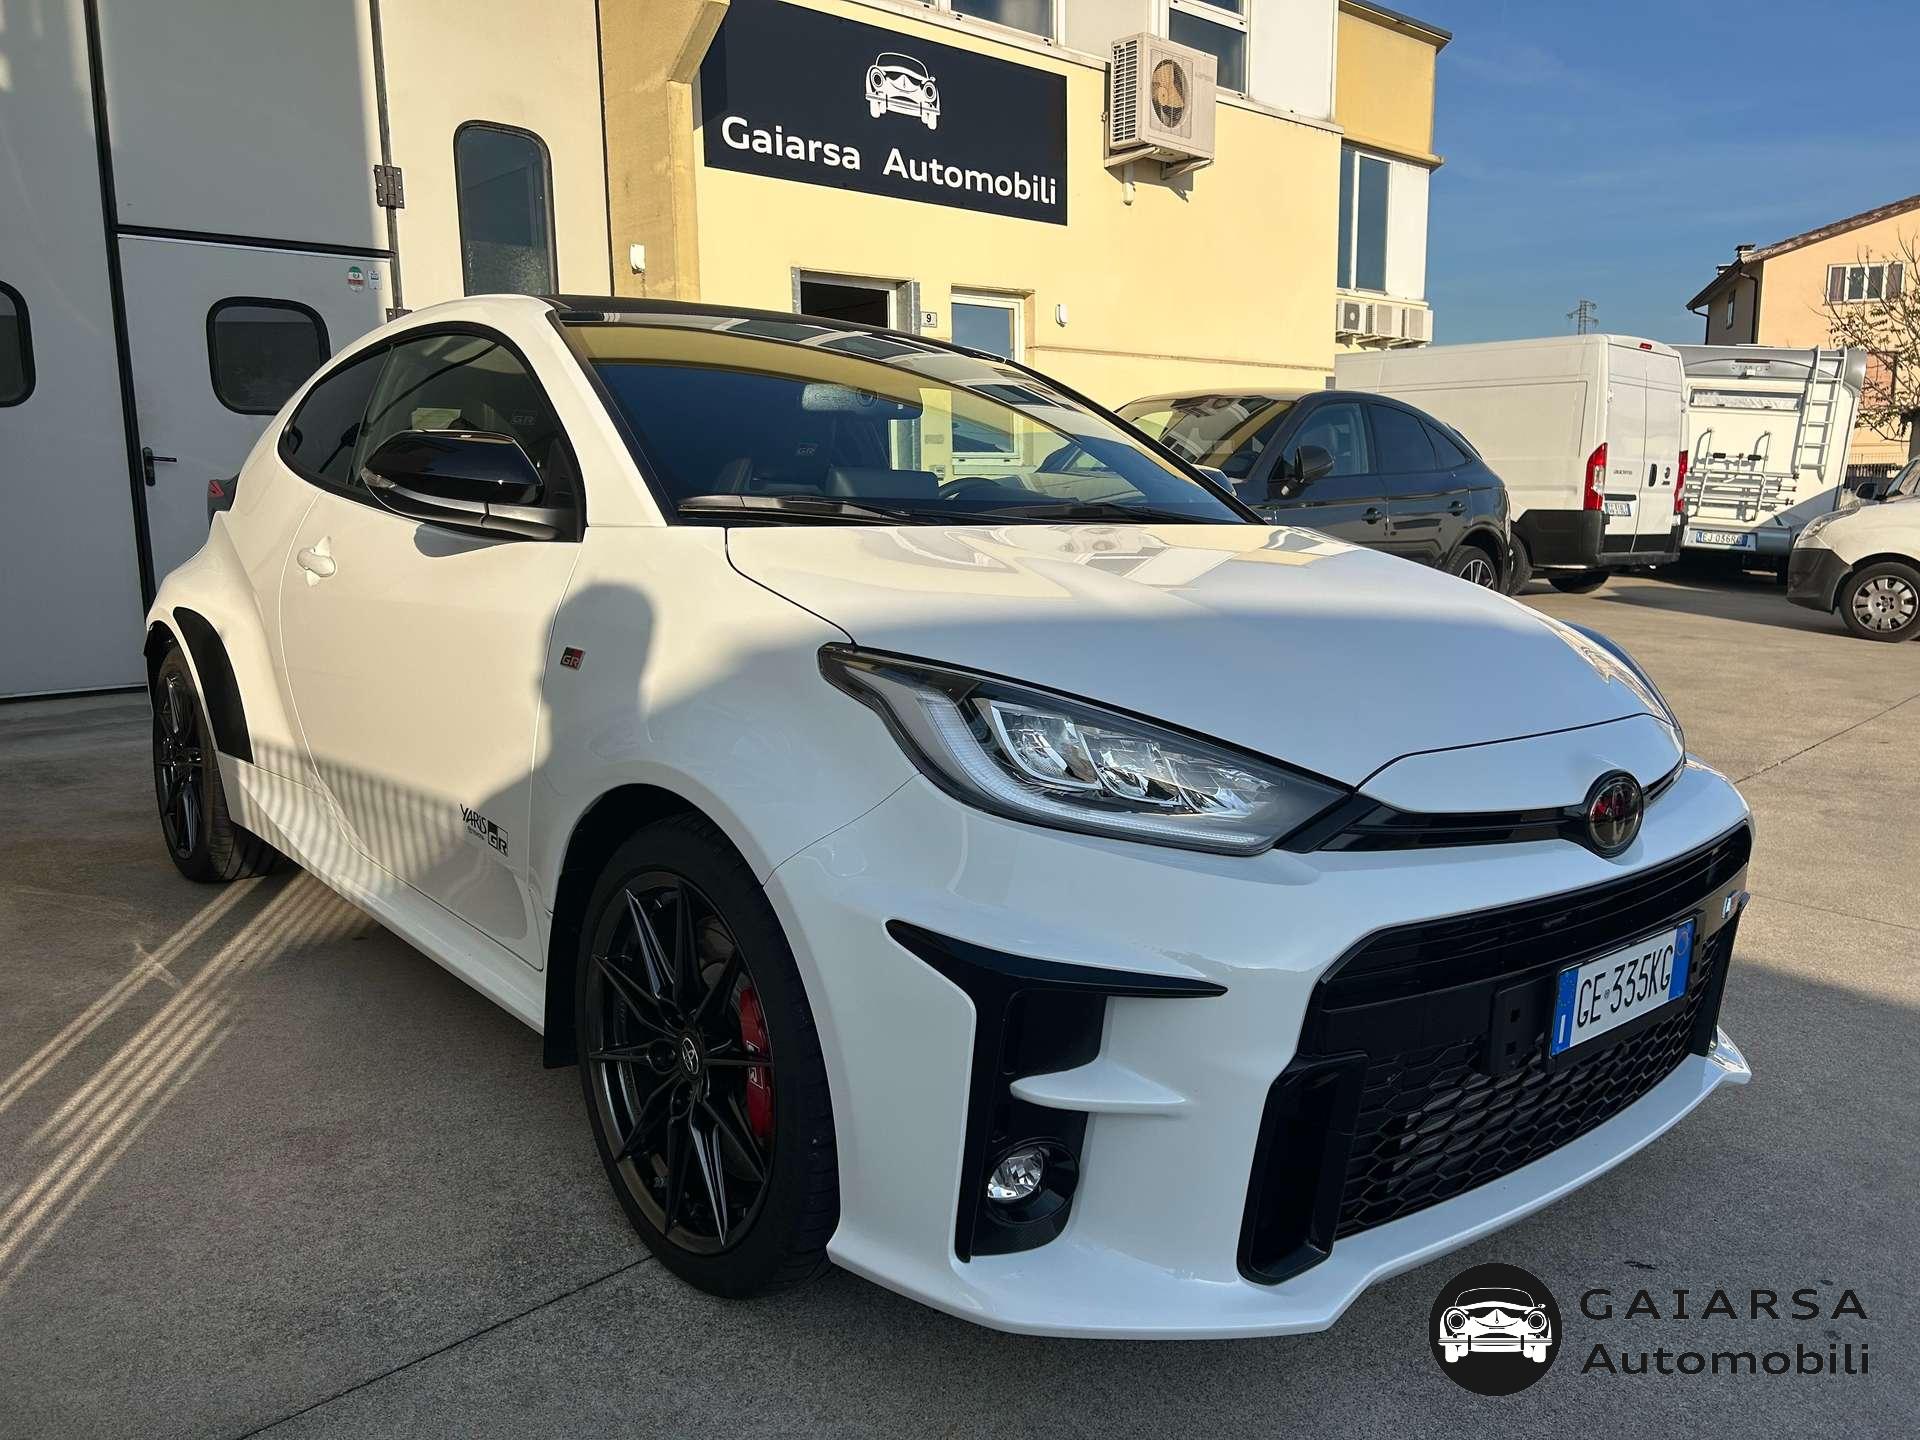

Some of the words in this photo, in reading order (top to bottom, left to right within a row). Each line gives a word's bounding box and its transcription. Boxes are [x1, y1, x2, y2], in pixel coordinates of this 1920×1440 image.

[721, 115, 861, 171] Gaiarsa
[881, 147, 1057, 205] Automobili
[926, 313, 932, 323] 9
[562, 654, 581, 668] GR
[460, 803, 487, 835] YARIS
[488, 829, 509, 857] GR
